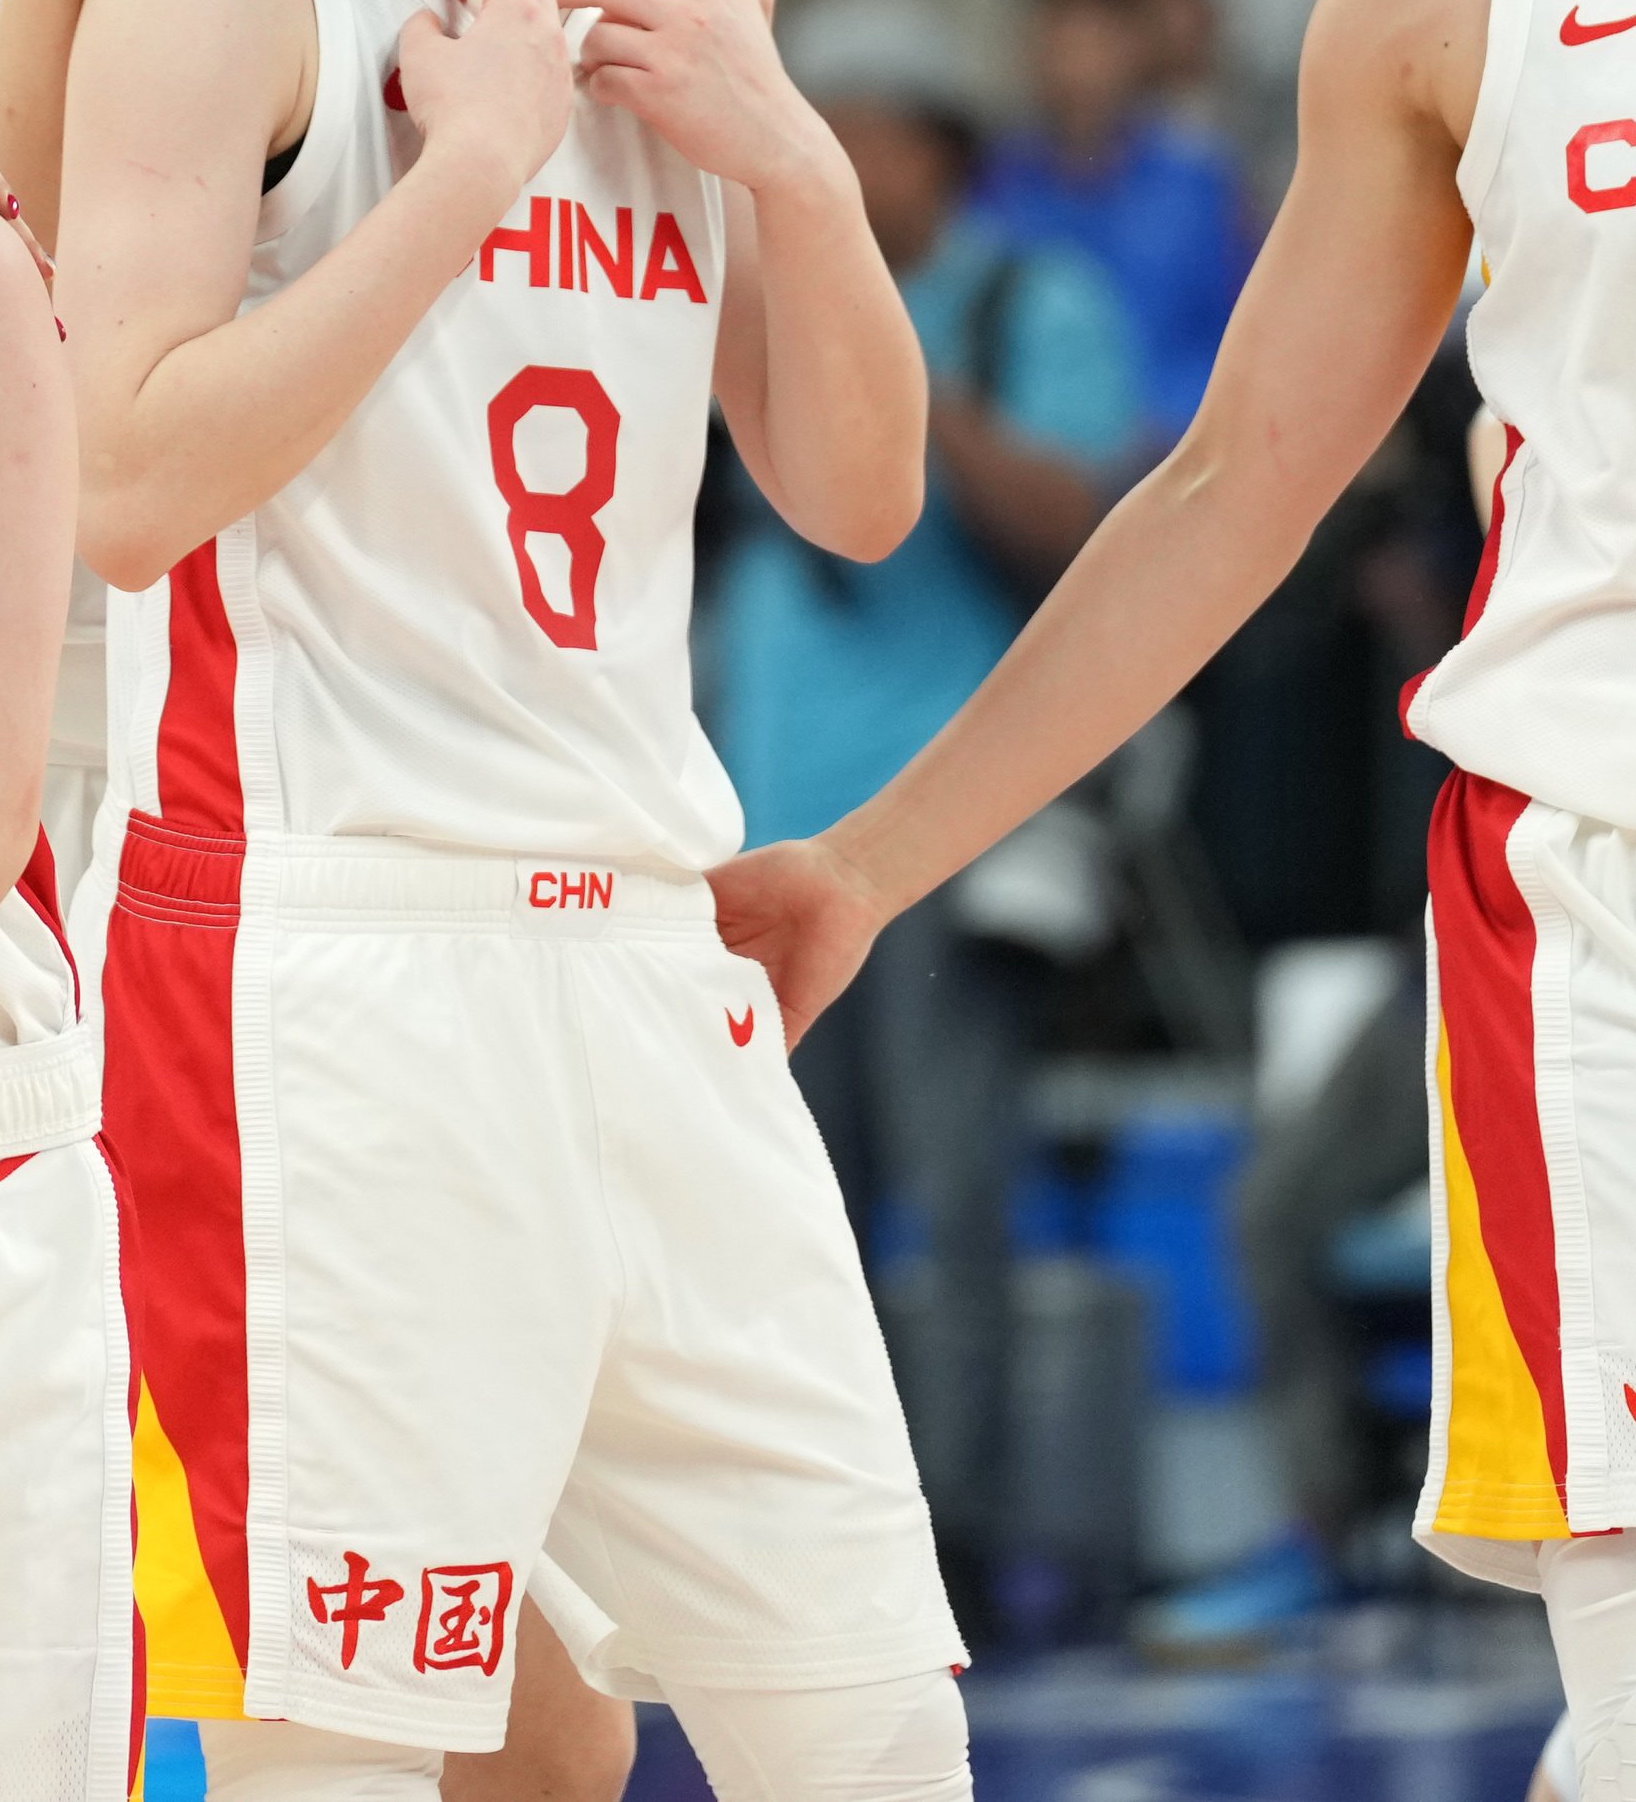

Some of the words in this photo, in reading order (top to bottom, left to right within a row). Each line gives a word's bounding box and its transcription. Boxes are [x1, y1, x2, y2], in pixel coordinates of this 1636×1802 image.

[476, 195, 708, 304] HINA
[486, 364, 622, 652] 8
[528, 871, 614, 909] CHN
[307, 1550, 514, 1677] 中国
